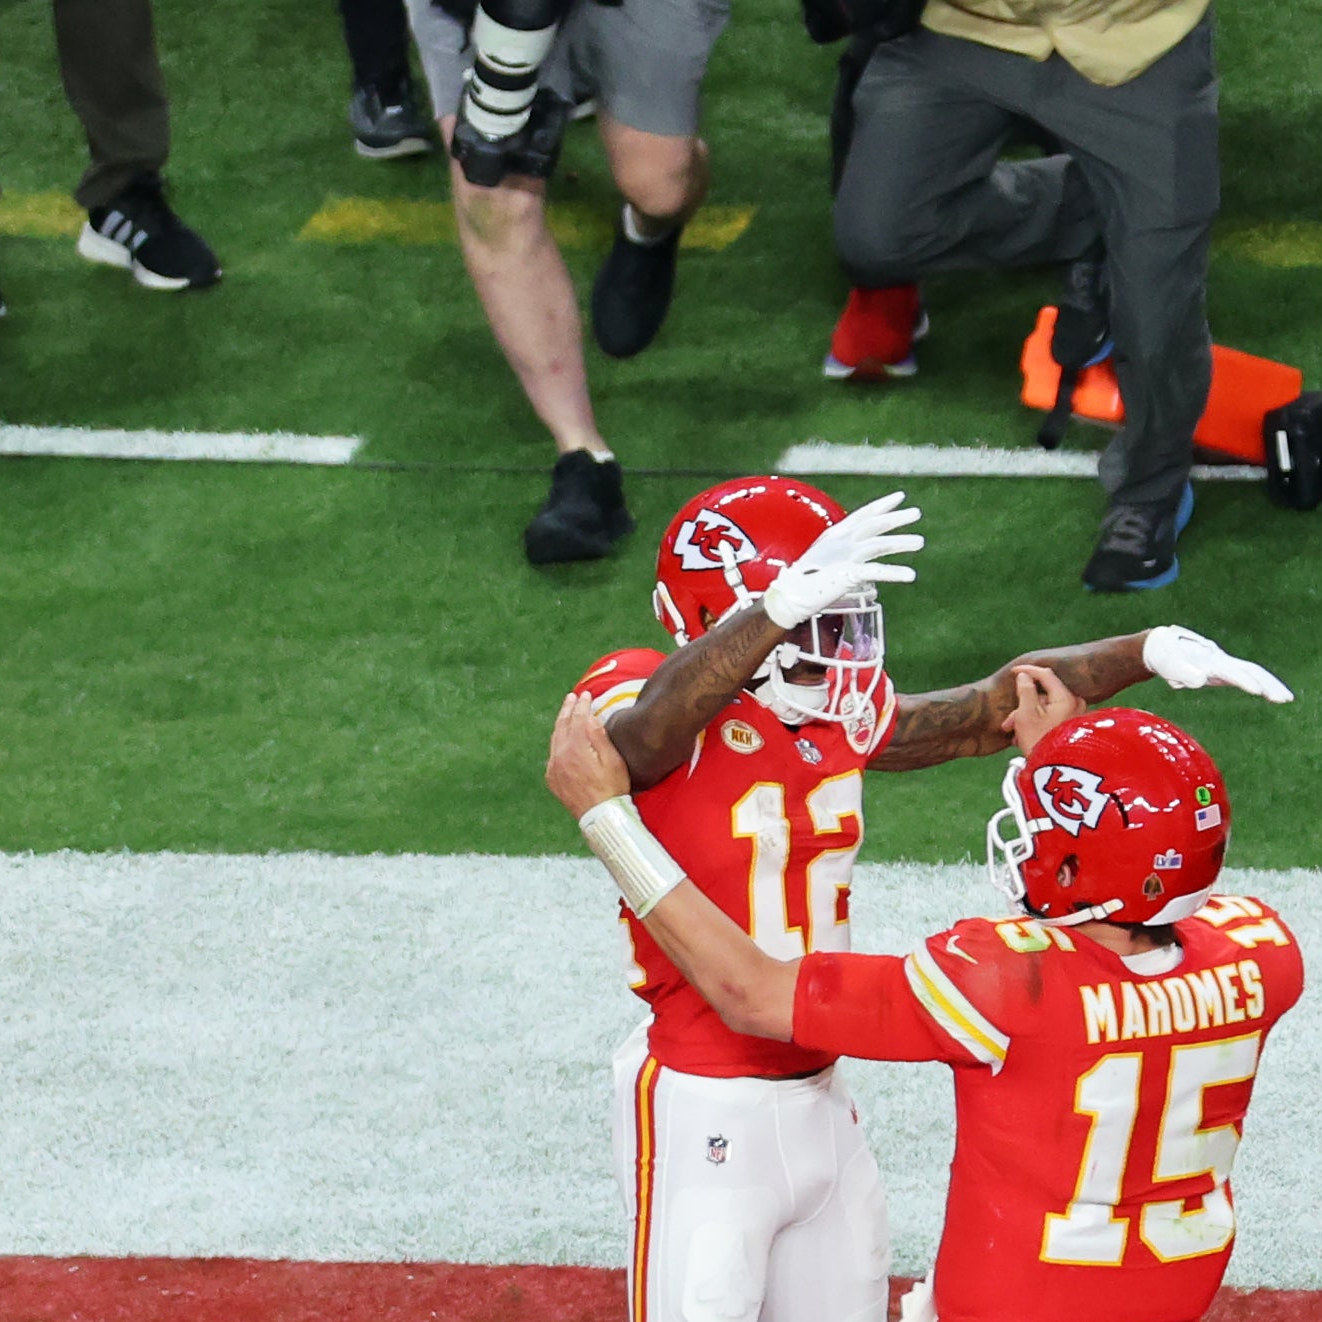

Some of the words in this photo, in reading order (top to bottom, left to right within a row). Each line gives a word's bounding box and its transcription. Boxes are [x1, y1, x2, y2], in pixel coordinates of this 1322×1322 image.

[1044, 767, 1092, 821] KC
[731, 768, 864, 962] 12
[1079, 959, 1265, 1045] MAHOMES
[1039, 1030, 1263, 1267] 15
